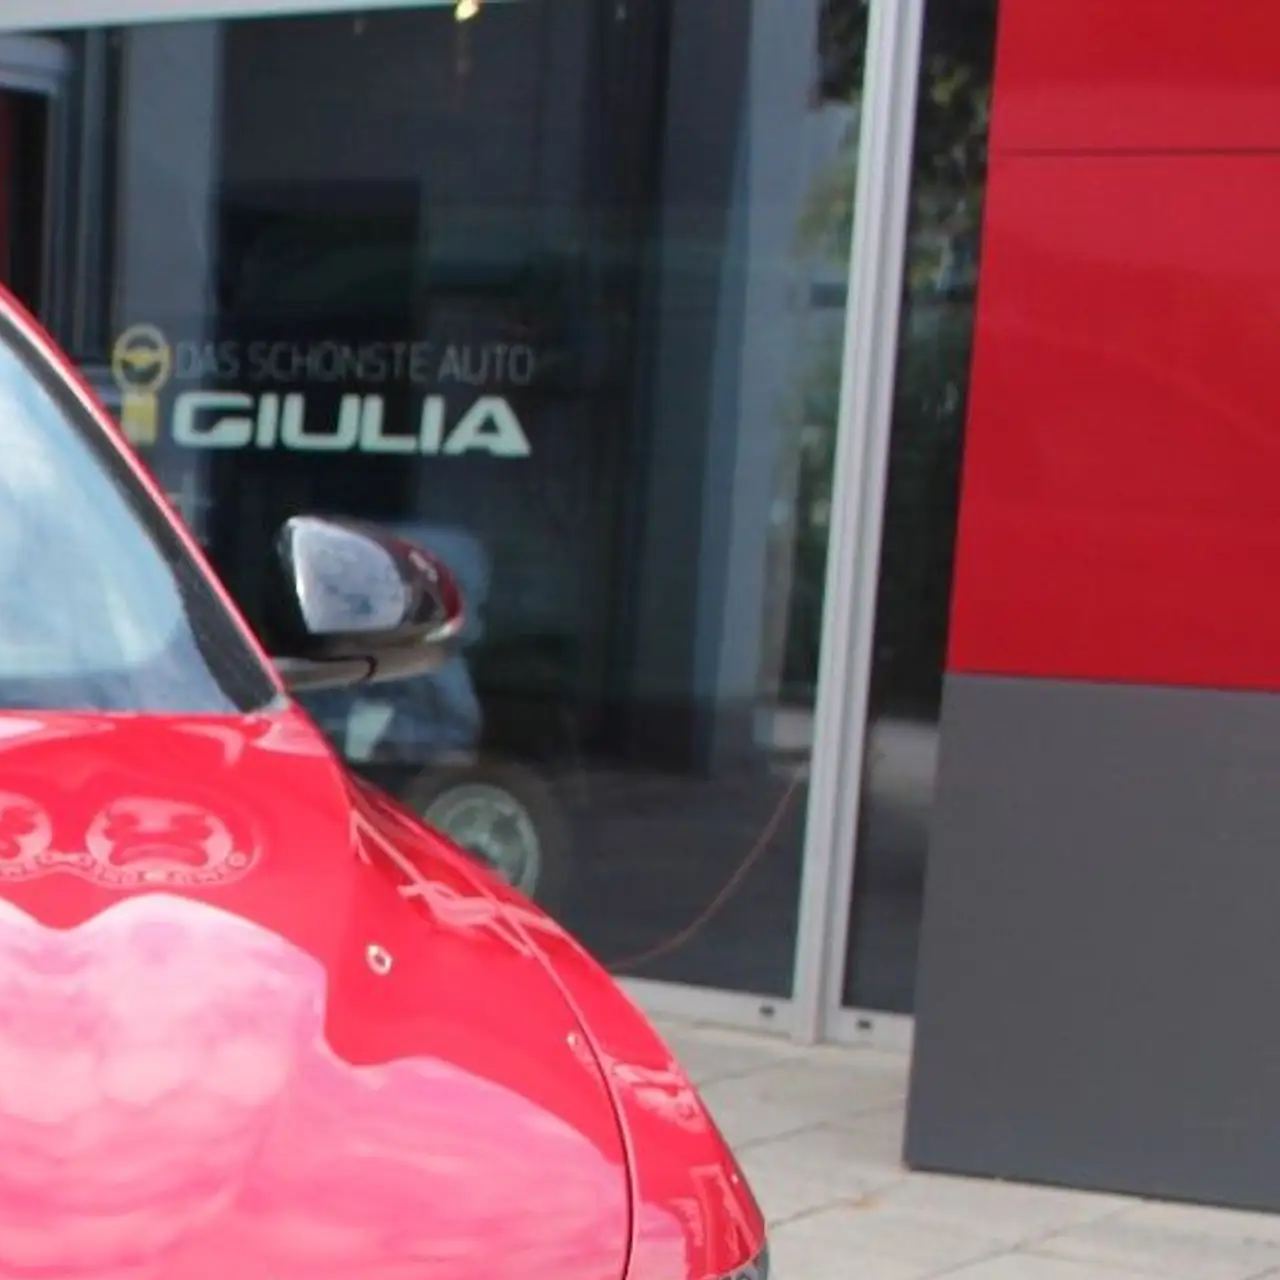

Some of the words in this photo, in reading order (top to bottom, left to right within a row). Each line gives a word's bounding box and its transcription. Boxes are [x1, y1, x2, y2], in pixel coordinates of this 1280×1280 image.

[174, 341, 240, 381] DAS
[438, 342, 536, 386] AUTO
[171, 391, 532, 457] GIULIA
